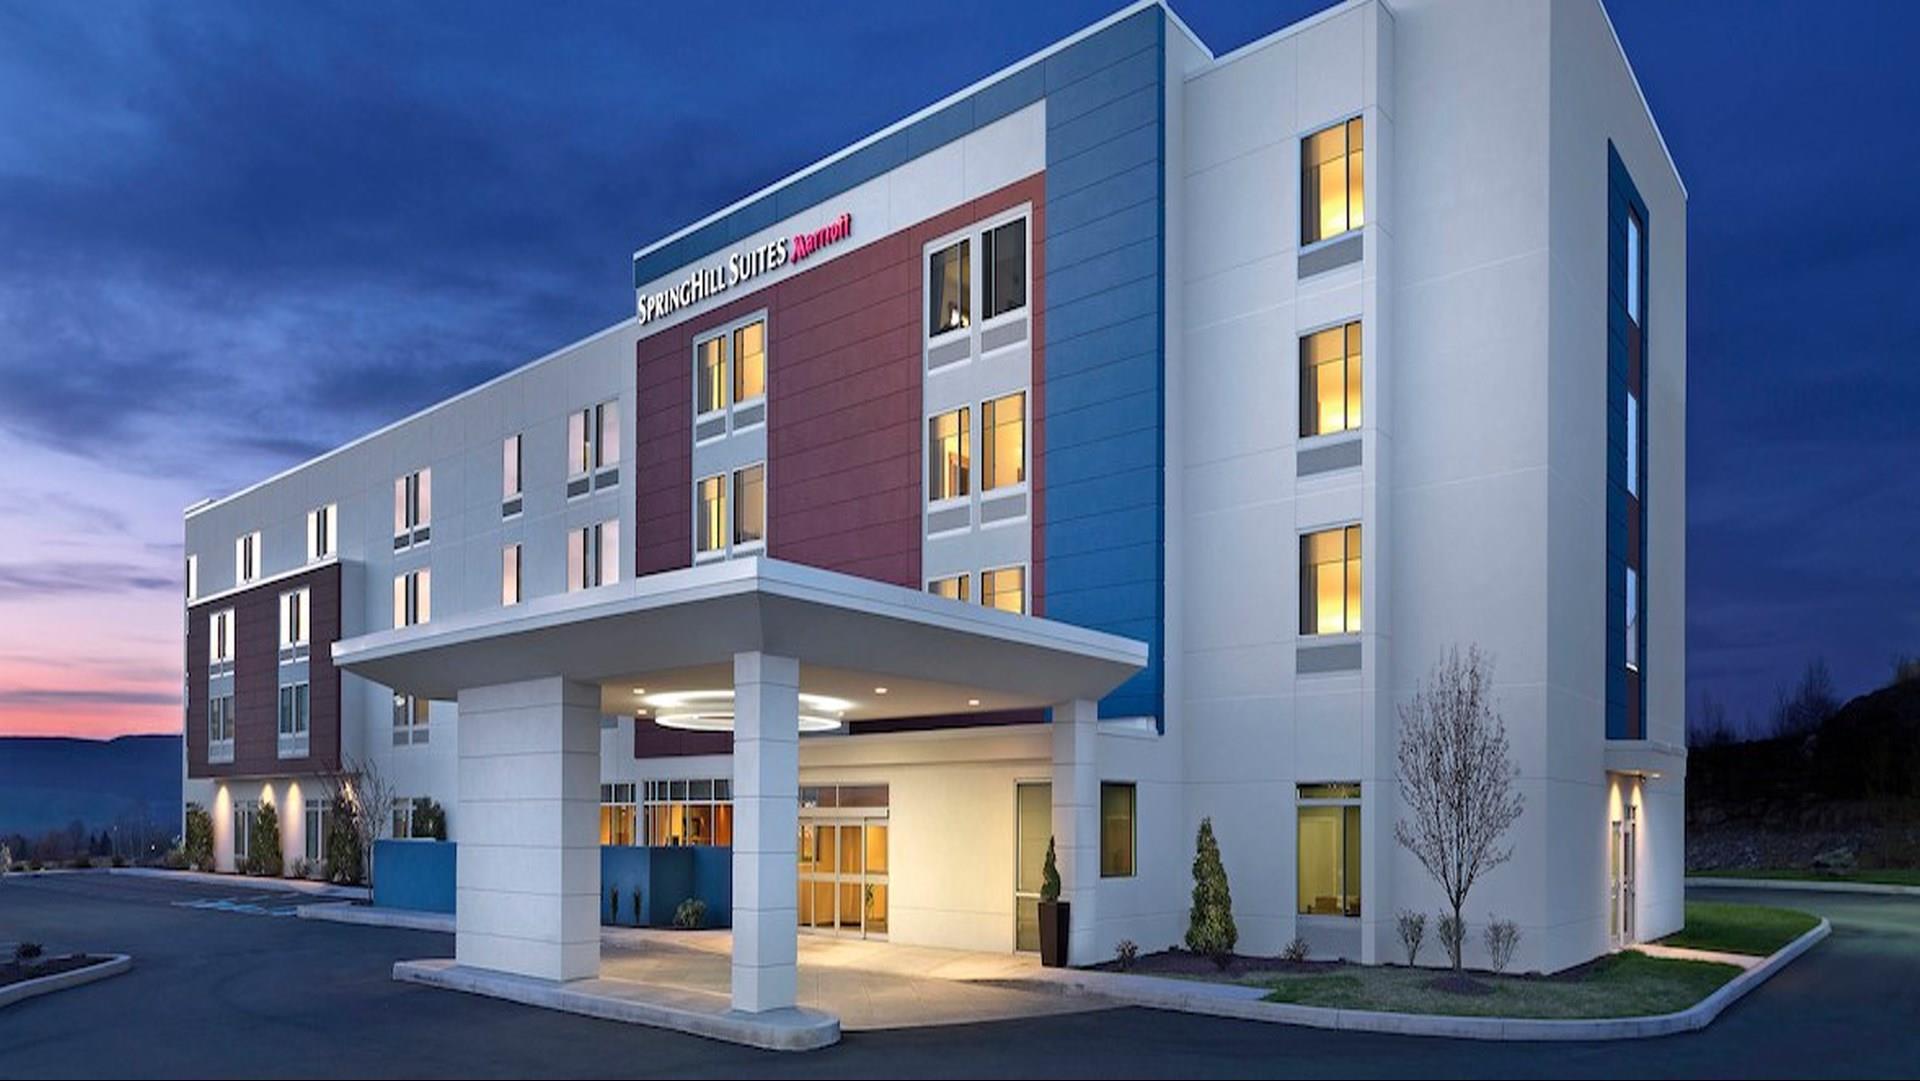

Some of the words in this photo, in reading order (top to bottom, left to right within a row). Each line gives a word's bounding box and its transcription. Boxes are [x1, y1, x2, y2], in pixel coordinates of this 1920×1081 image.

[638, 266, 726, 325] SPRINGHILL
[729, 237, 787, 284] SUITES
[790, 212, 852, 264] Marriott
